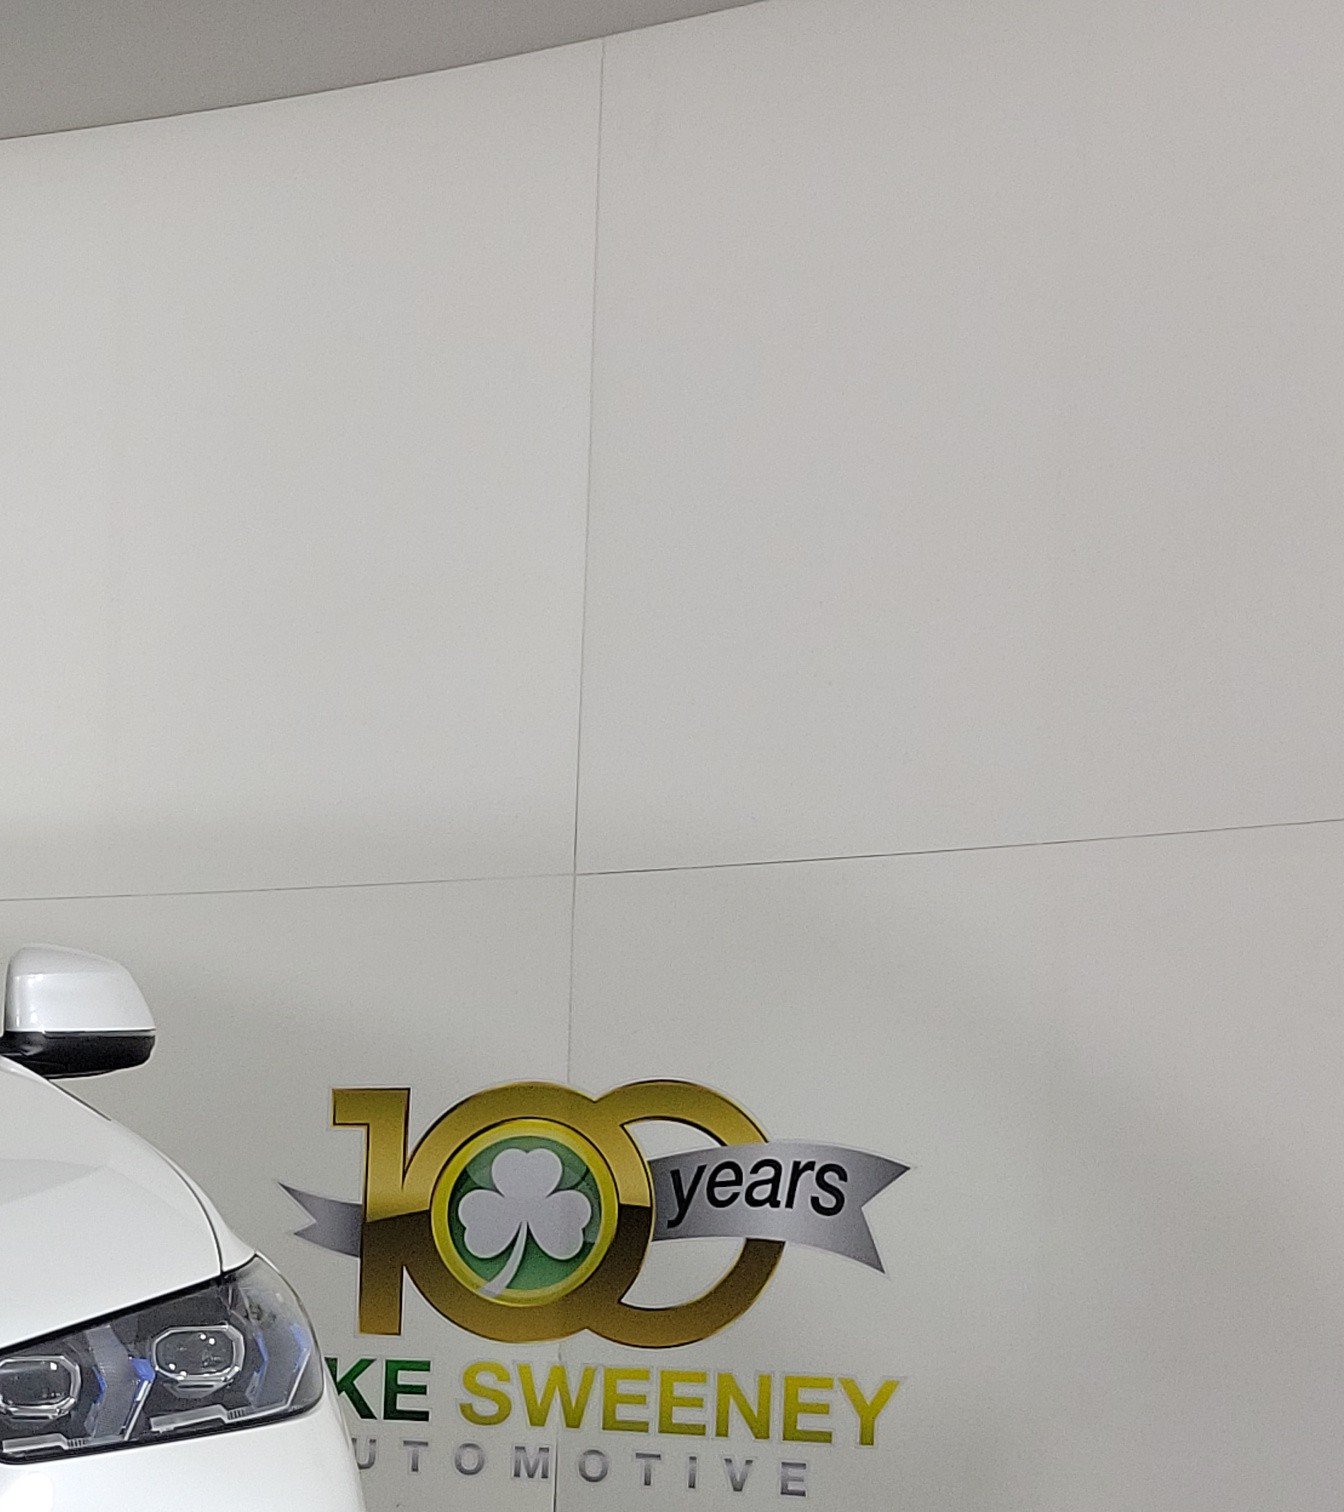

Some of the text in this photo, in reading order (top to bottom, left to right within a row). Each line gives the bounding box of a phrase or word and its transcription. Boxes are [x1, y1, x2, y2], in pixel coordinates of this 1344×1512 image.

[332, 1079, 848, 1348] 100 years
[459, 1361, 899, 1446] SWEENEY
[351, 1437, 807, 1497] UTOMOTIVE
